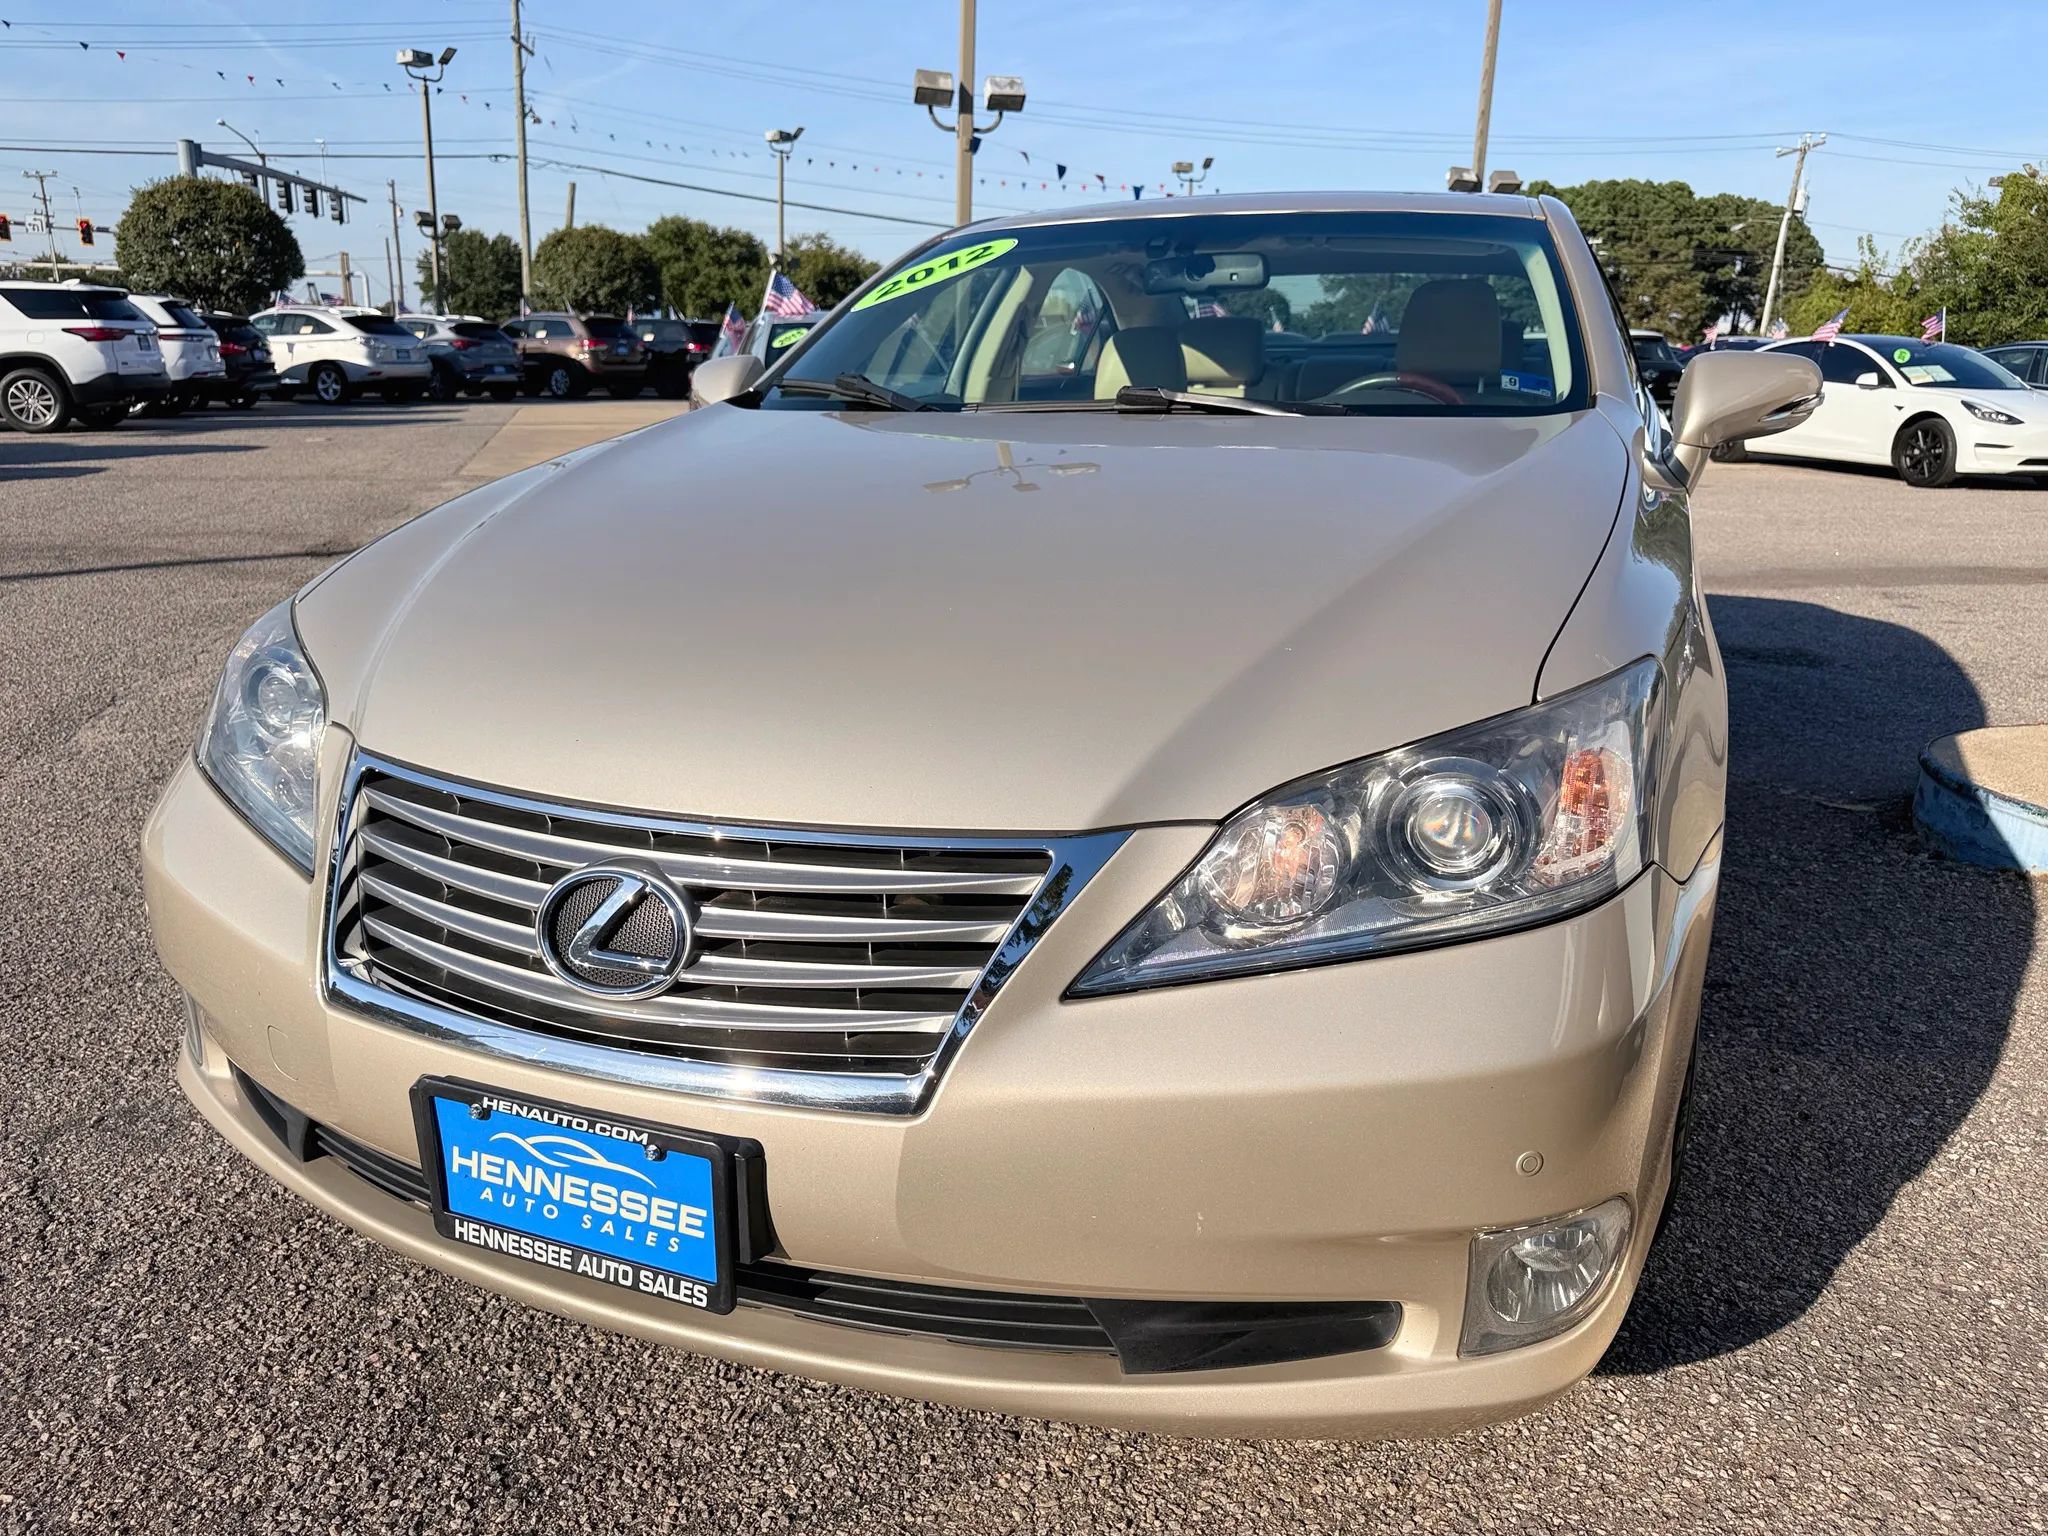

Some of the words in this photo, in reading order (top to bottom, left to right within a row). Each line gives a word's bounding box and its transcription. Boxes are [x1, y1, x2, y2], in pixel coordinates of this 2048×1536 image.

[874, 245, 995, 301] 2012
[482, 1096, 649, 1145] HENAUTO.COM
[452, 1145, 708, 1239] HENNESSEE
[479, 1188, 559, 1220] AUTO
[581, 1215, 680, 1252] SALES
[454, 1218, 573, 1271] HENNESSEE
[577, 1253, 634, 1288] AUTO
[638, 1269, 709, 1308] SALES
